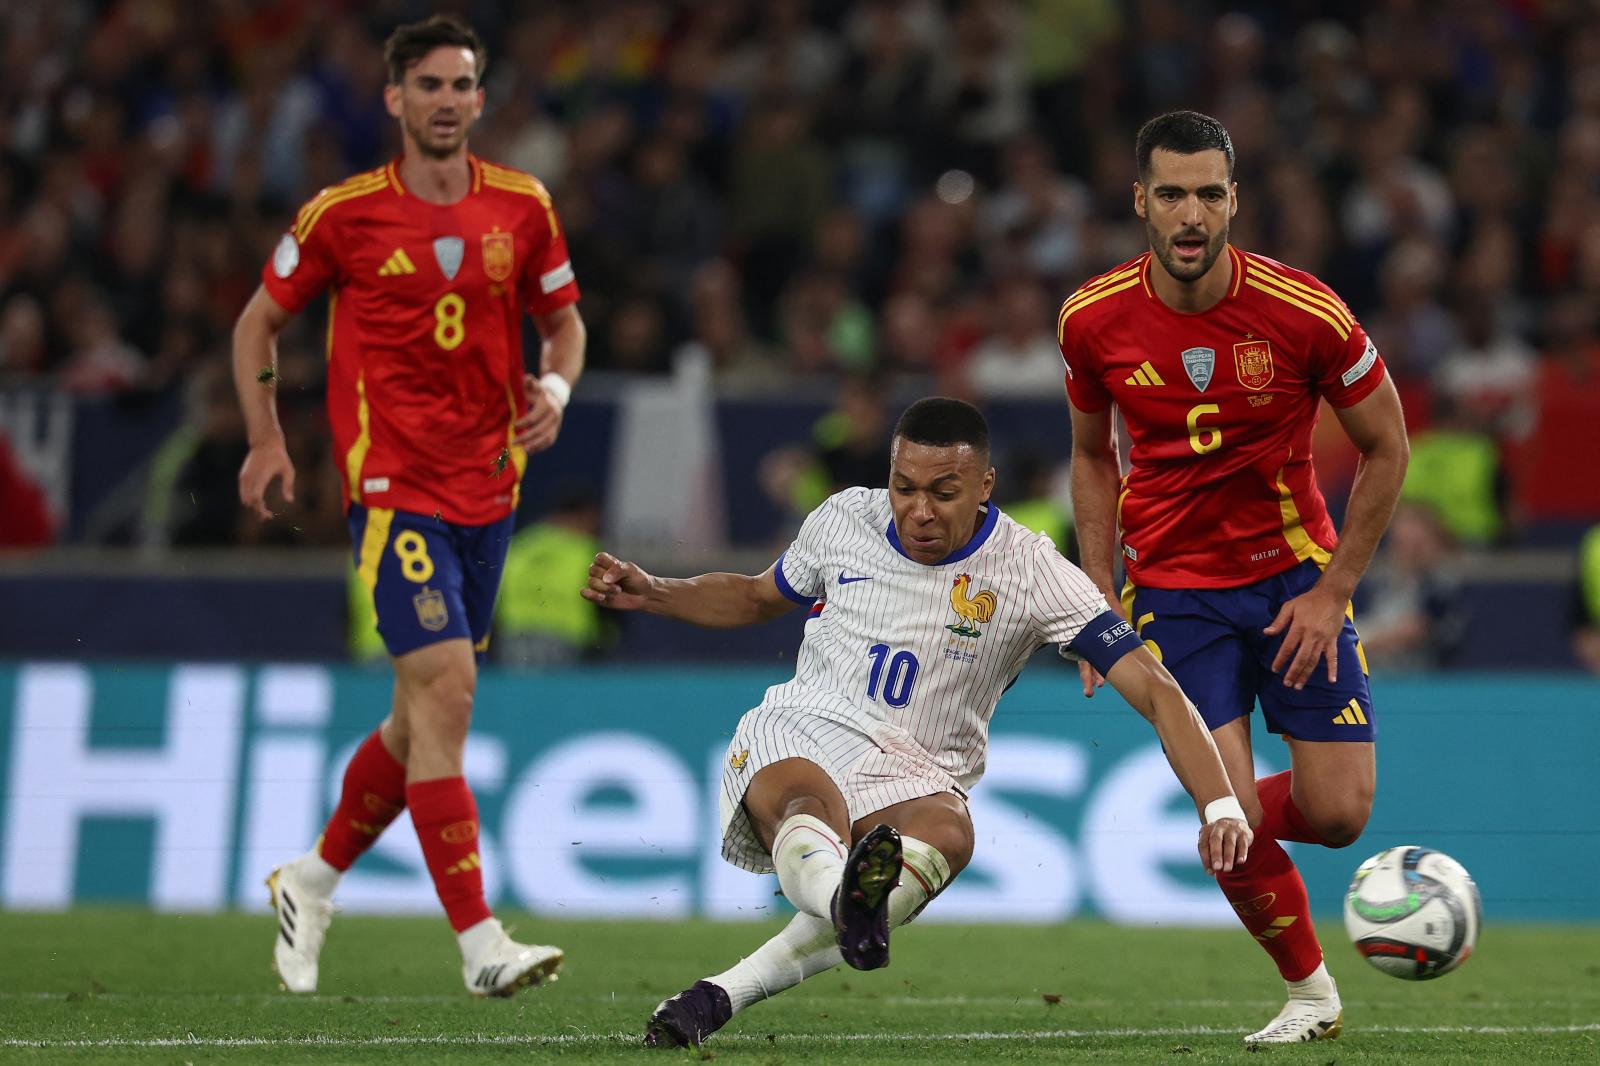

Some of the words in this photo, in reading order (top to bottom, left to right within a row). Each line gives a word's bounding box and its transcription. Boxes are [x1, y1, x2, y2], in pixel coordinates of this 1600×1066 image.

[434, 292, 466, 352] 8
[1187, 403, 1222, 455] 6
[394, 529, 436, 584] 8
[867, 643, 920, 709] 10
[4, 664, 1292, 918] Hisese
